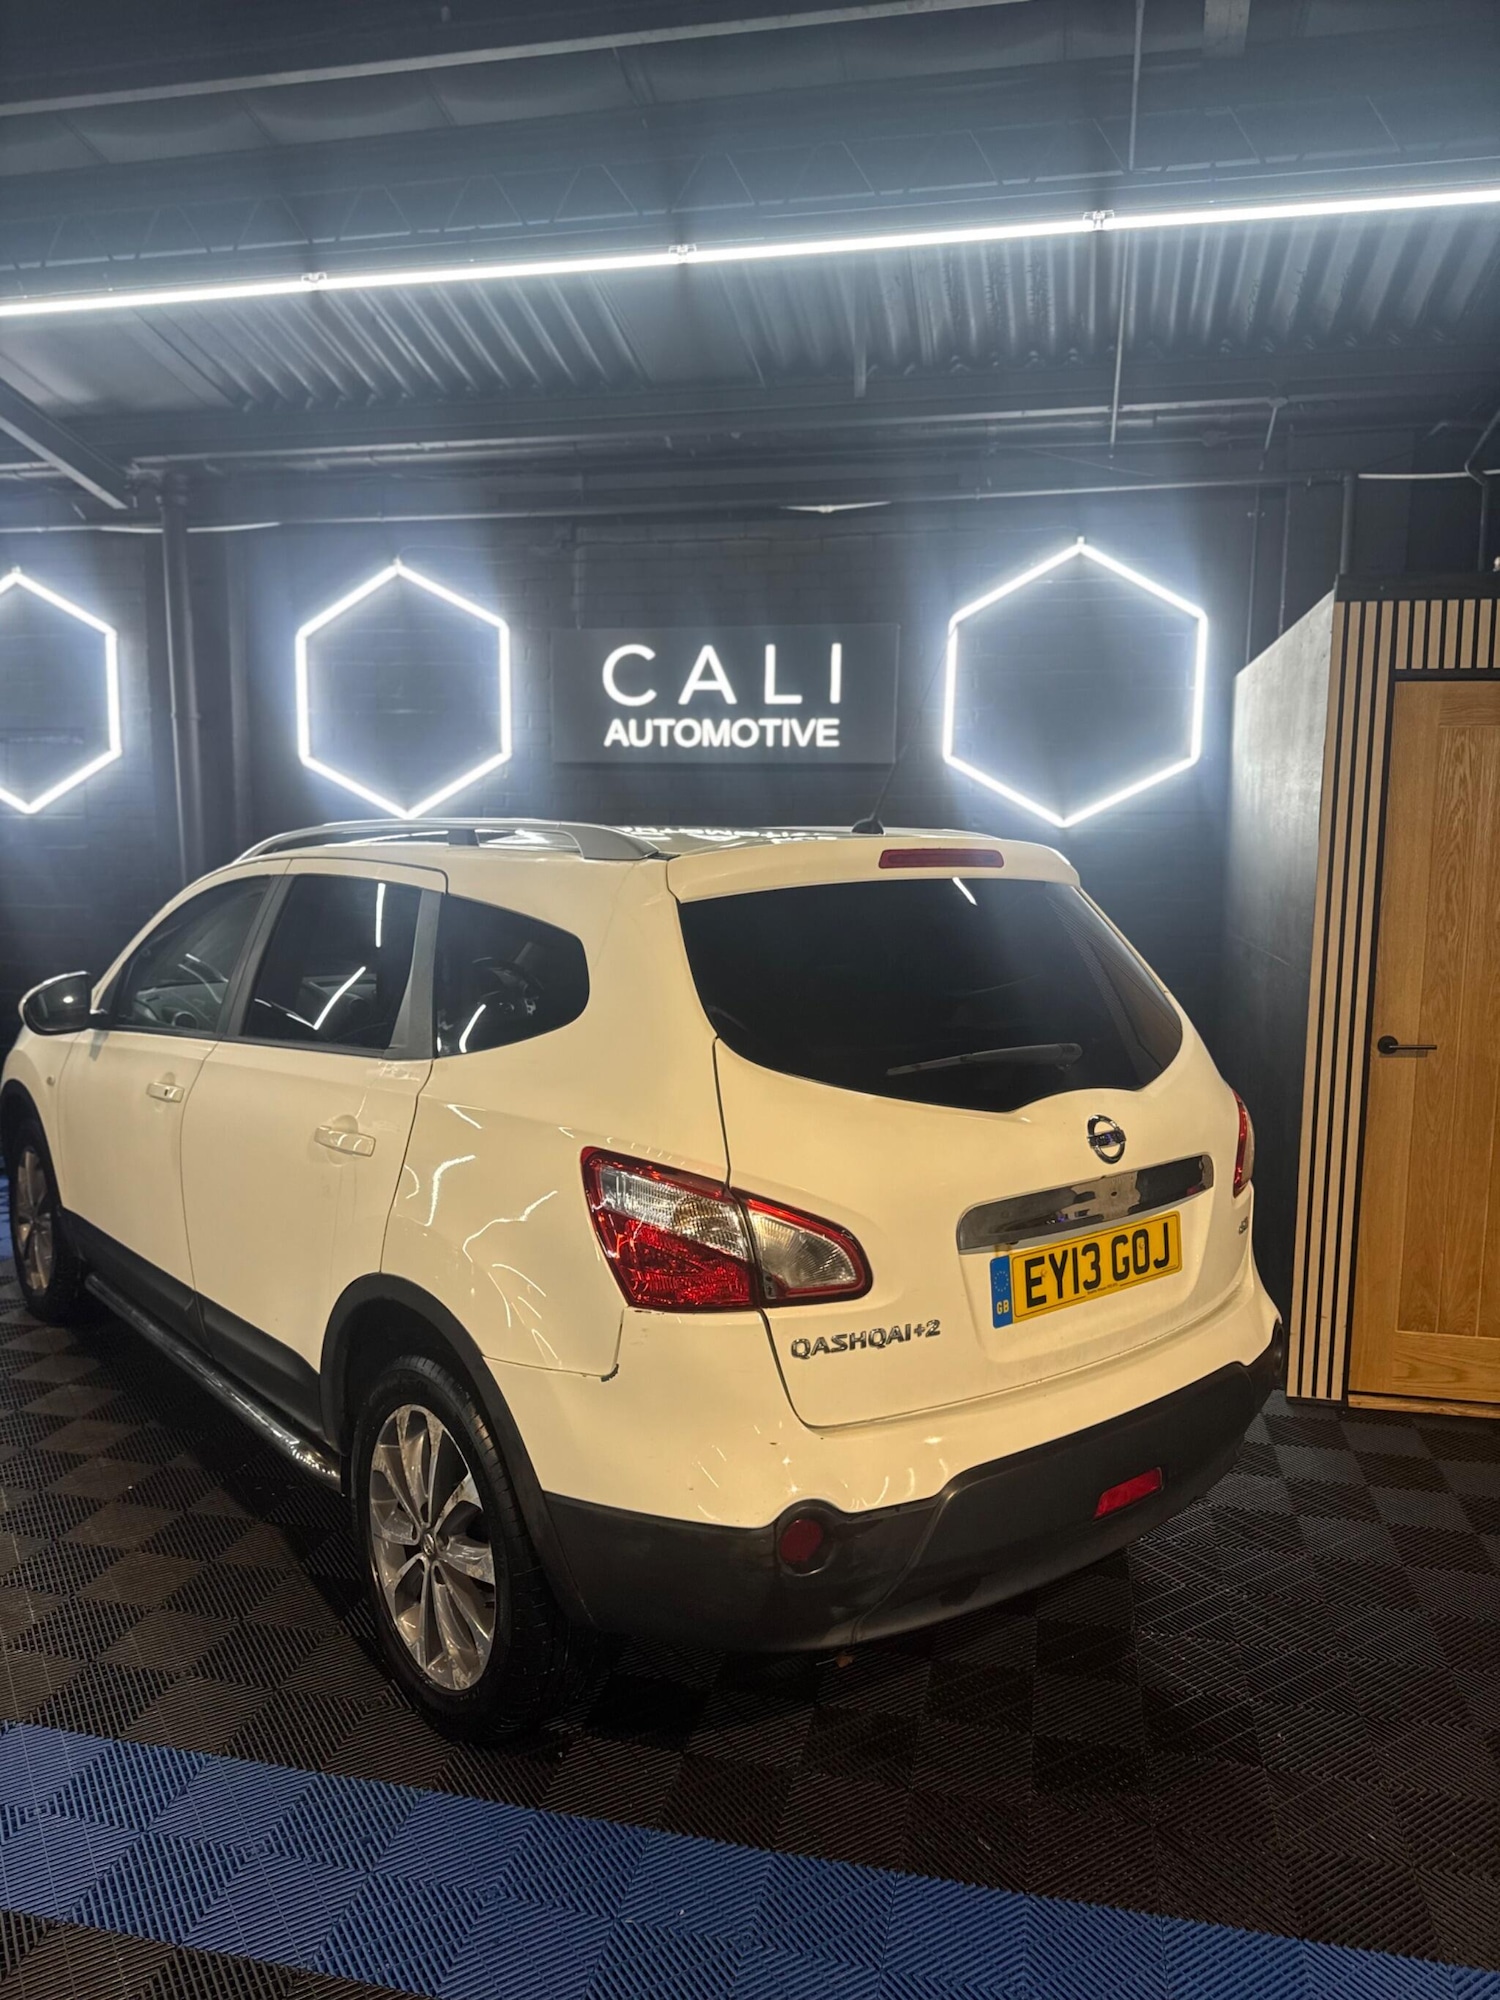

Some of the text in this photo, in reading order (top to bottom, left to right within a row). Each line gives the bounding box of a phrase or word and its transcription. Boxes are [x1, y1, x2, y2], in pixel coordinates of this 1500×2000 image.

[602, 642, 842, 706] CALI
[604, 717, 840, 748] AUTOMOTIVE
[1024, 1222, 1170, 1309] EY13 GOJ
[996, 1300, 1010, 1316] GB
[790, 1319, 941, 1360] QASHQAI+2
